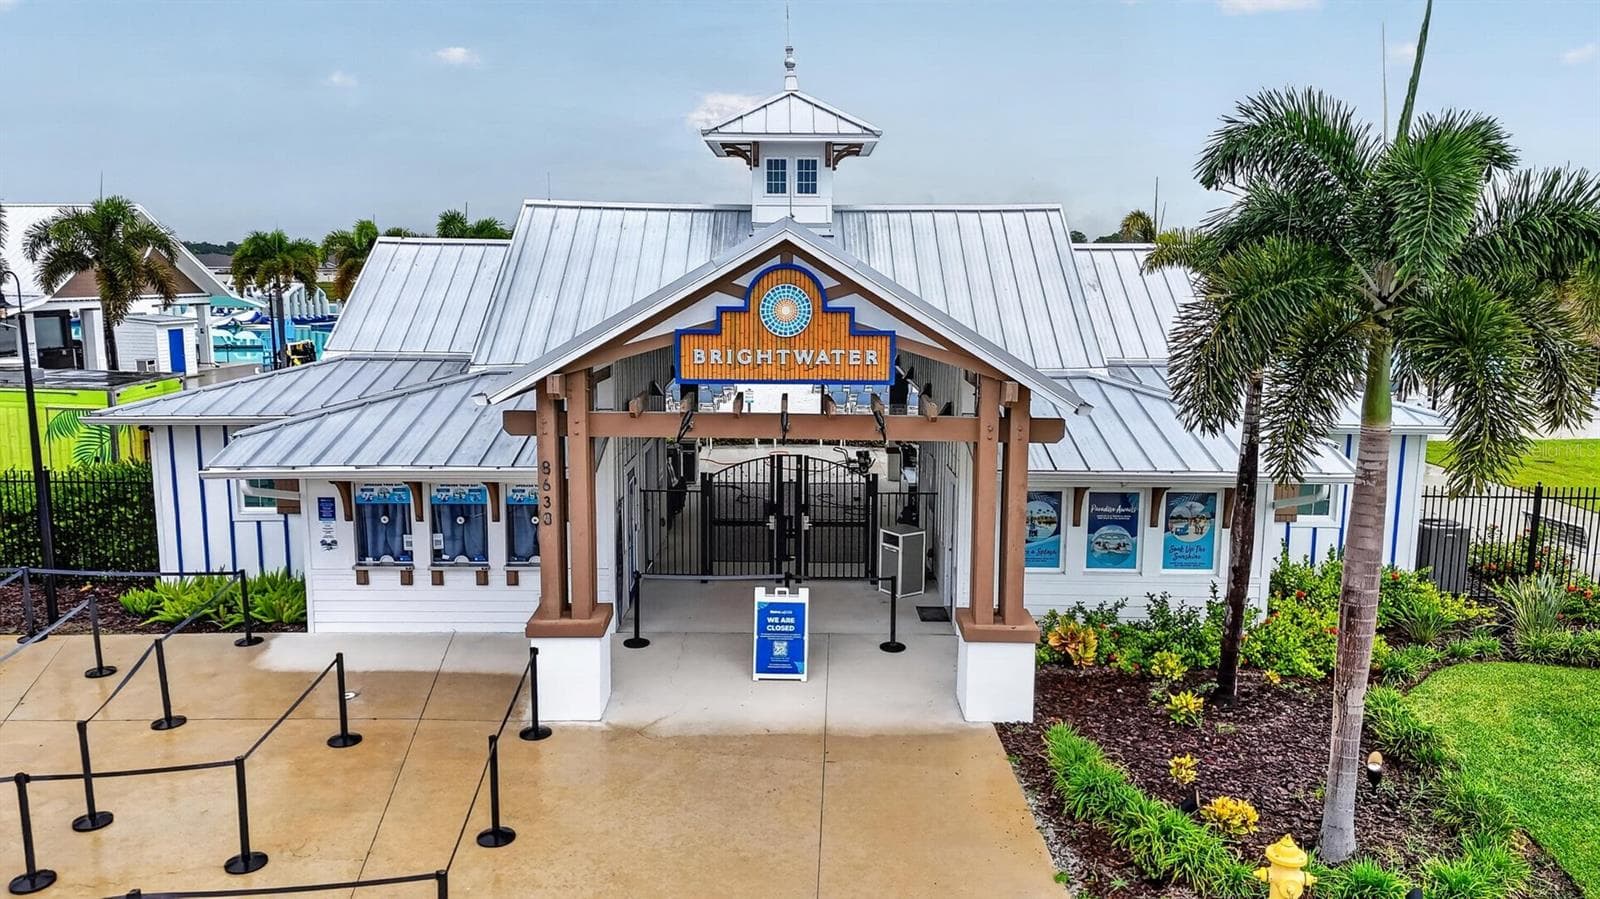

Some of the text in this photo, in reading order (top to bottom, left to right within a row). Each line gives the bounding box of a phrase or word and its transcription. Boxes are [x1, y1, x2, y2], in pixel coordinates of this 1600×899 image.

[692, 349, 879, 366] BRIGHTWATER
[1090, 504, 1136, 514] Paradise Awaits
[1173, 551, 1201, 560] Sunshine
